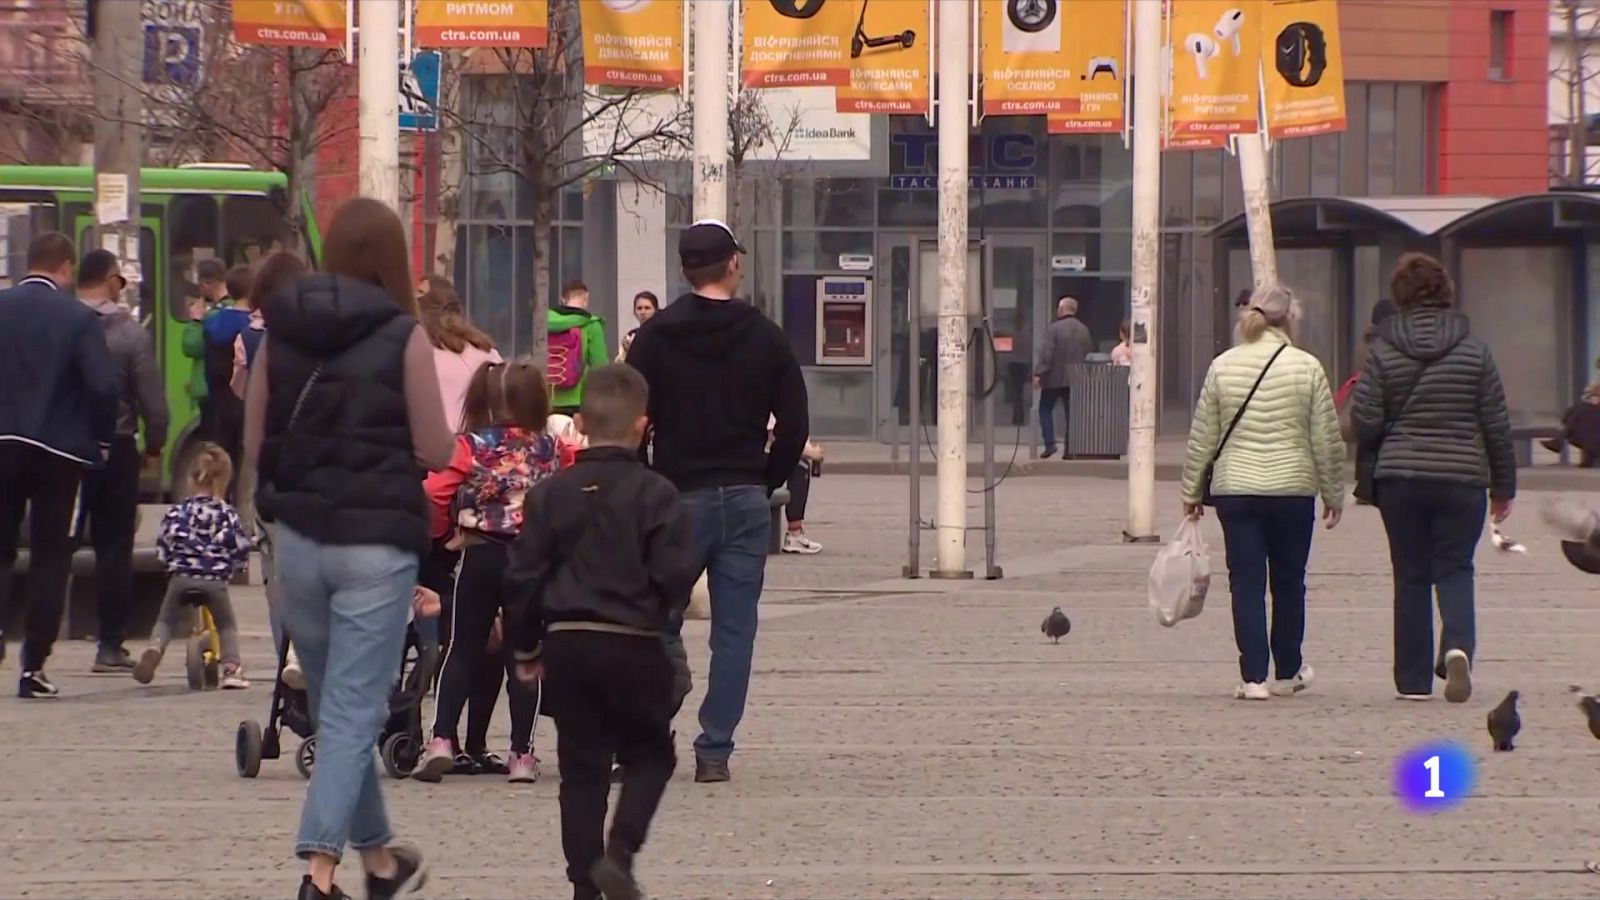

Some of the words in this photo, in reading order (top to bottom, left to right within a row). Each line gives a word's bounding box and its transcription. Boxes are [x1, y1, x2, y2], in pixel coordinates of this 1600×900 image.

[446, 2, 514, 15] РИТМОМ
[257, 28, 327, 42] ctrs.com.ua
[440, 29, 520, 41] ctrs.com.ua
[606, 70, 663, 82] ctrs.com.ua
[763, 72, 827, 83] ctrs.com.ua
[855, 100, 911, 111] ctrs.com.ua
[1001, 100, 1061, 111] ctrs.com.ua
[1065, 120, 1113, 129] ctrs.com.ua
[1190, 123, 1240, 132] ctrs.com.ua
[899, 177, 1029, 188] ТАСМБАНК
